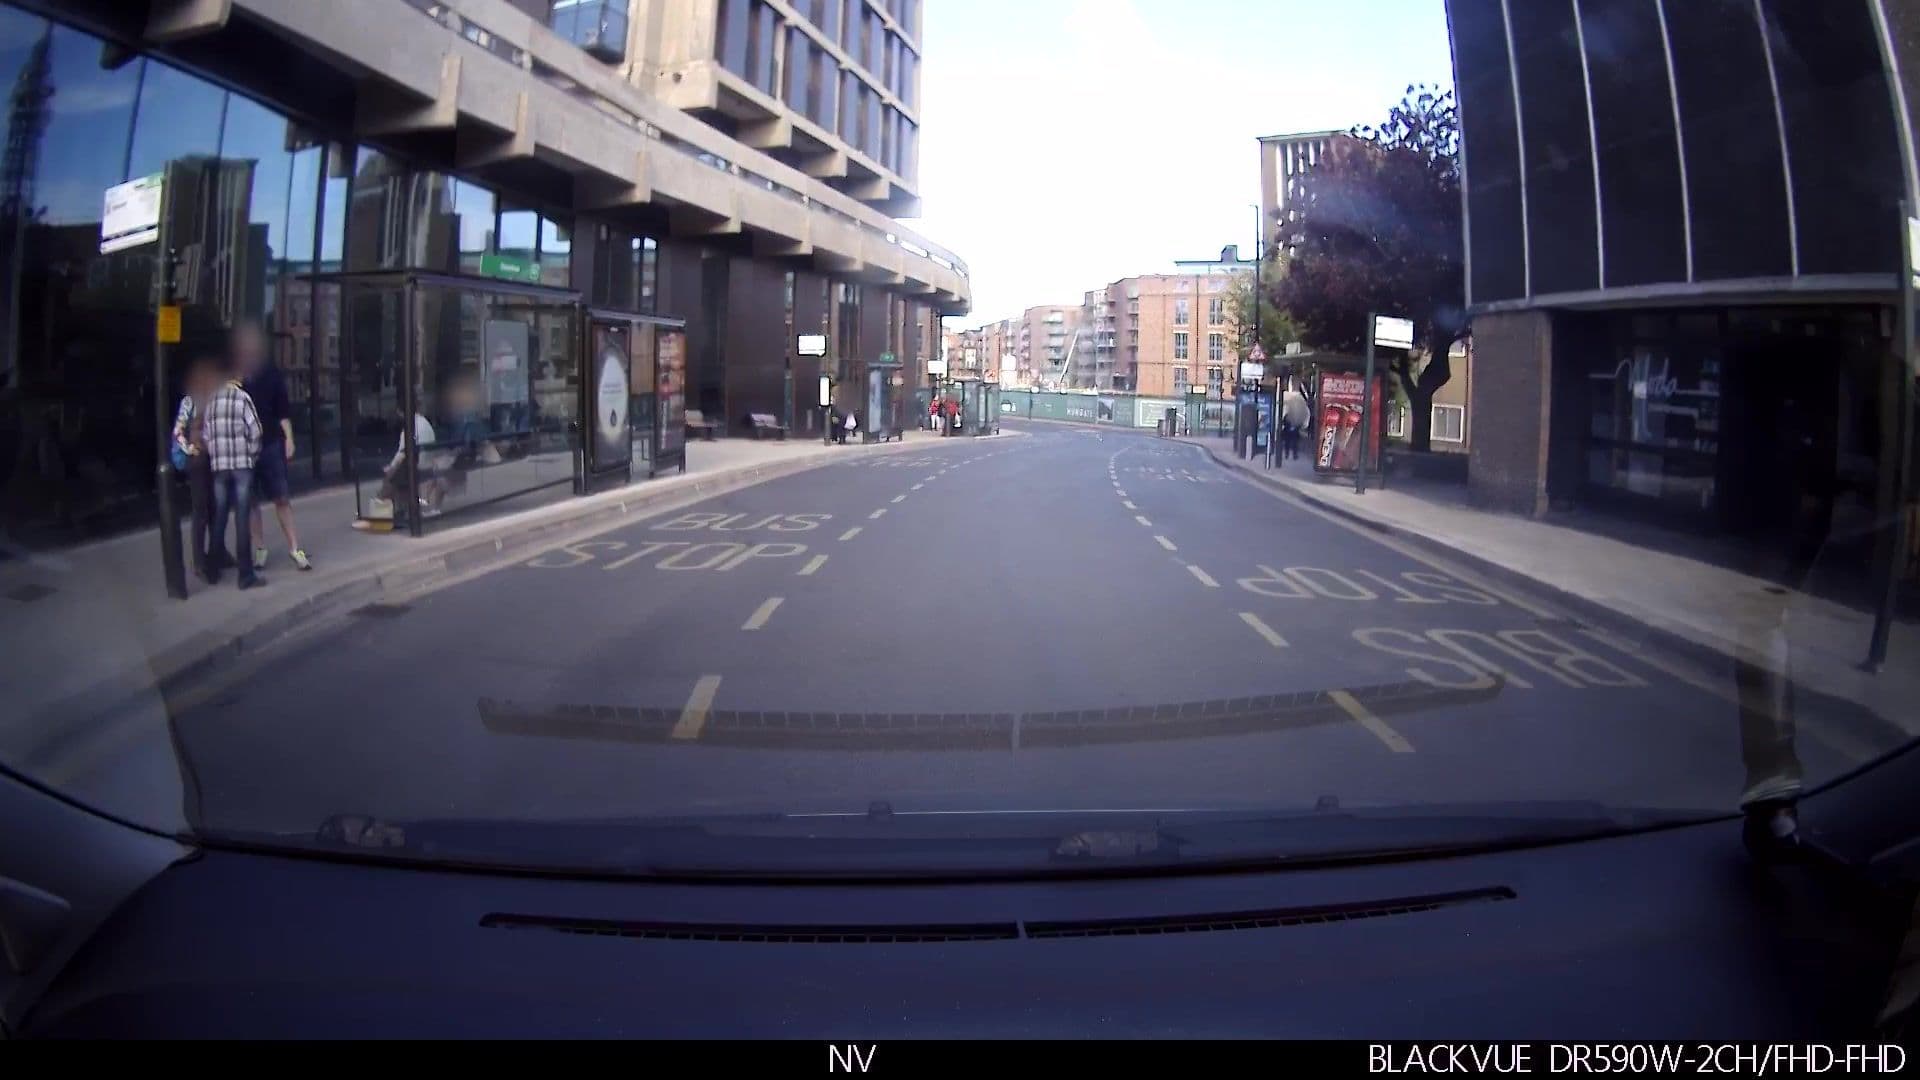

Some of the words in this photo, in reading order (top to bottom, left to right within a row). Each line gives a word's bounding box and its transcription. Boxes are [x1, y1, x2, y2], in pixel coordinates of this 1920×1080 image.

[650, 513, 833, 531] BUS
[526, 542, 809, 571] STOP
[1236, 564, 1501, 606] STOP
[1351, 627, 1649, 689] BUS
